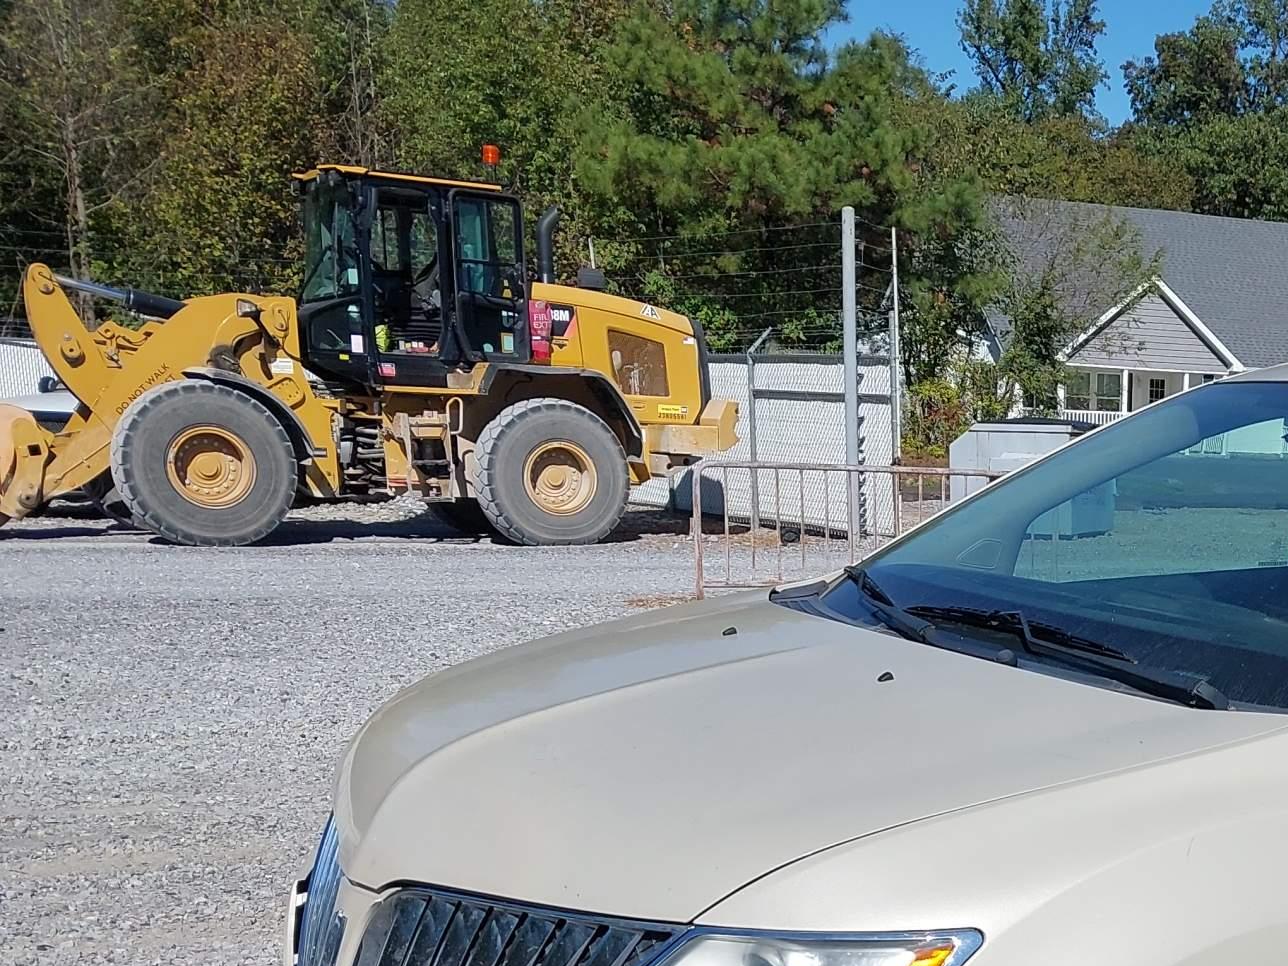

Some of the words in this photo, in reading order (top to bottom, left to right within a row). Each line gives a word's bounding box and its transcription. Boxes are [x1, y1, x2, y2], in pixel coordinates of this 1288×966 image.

[115, 401, 130, 415] DO
[128, 383, 146, 402] NOT
[145, 362, 170, 386] WALK
